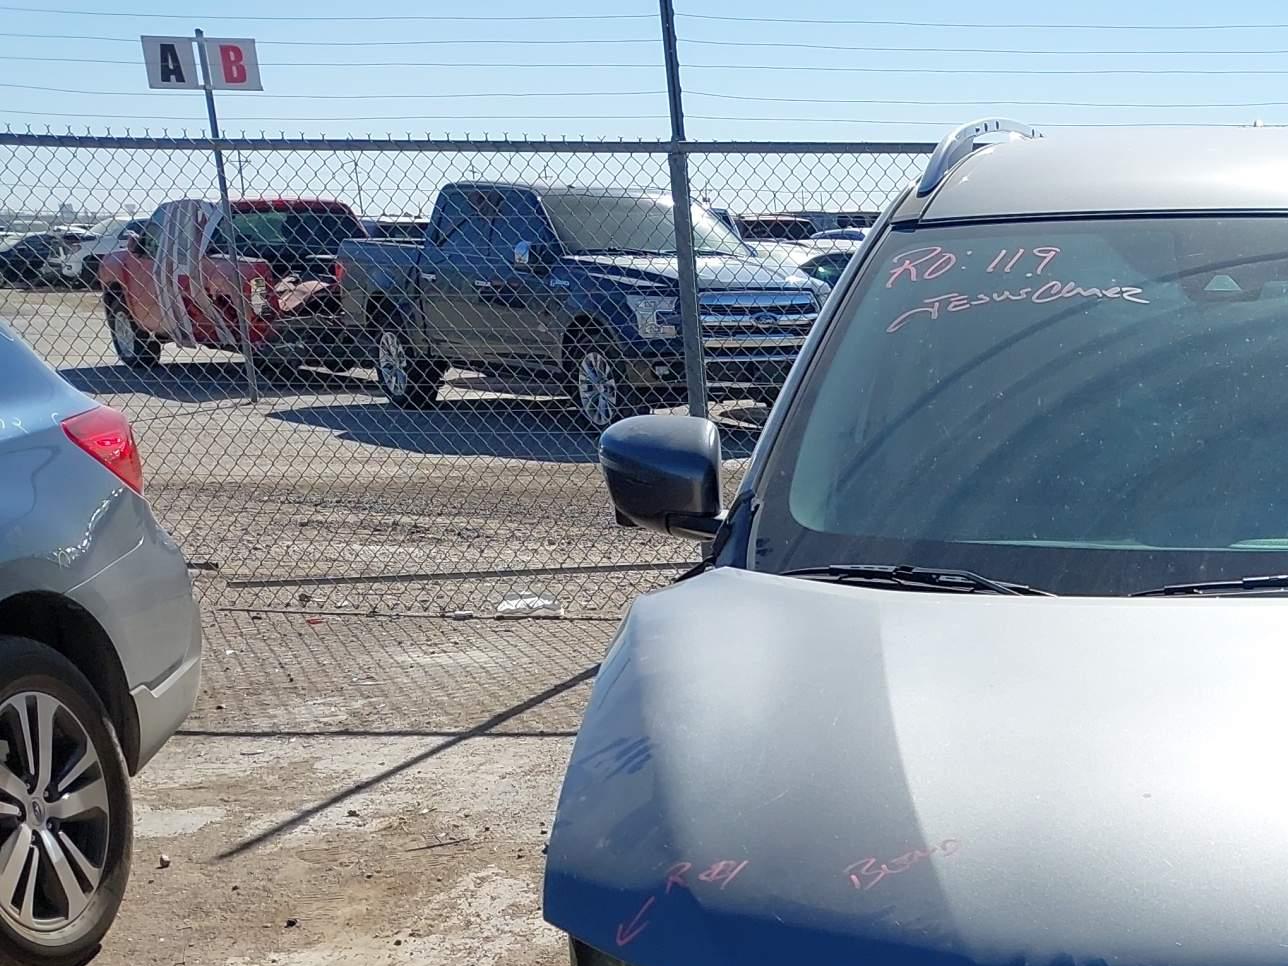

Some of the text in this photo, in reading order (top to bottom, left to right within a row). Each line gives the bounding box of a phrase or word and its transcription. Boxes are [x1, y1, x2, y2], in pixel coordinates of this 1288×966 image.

[159, 43, 186, 83] A
[218, 45, 248, 83] B
[986, 246, 1060, 275] 119
